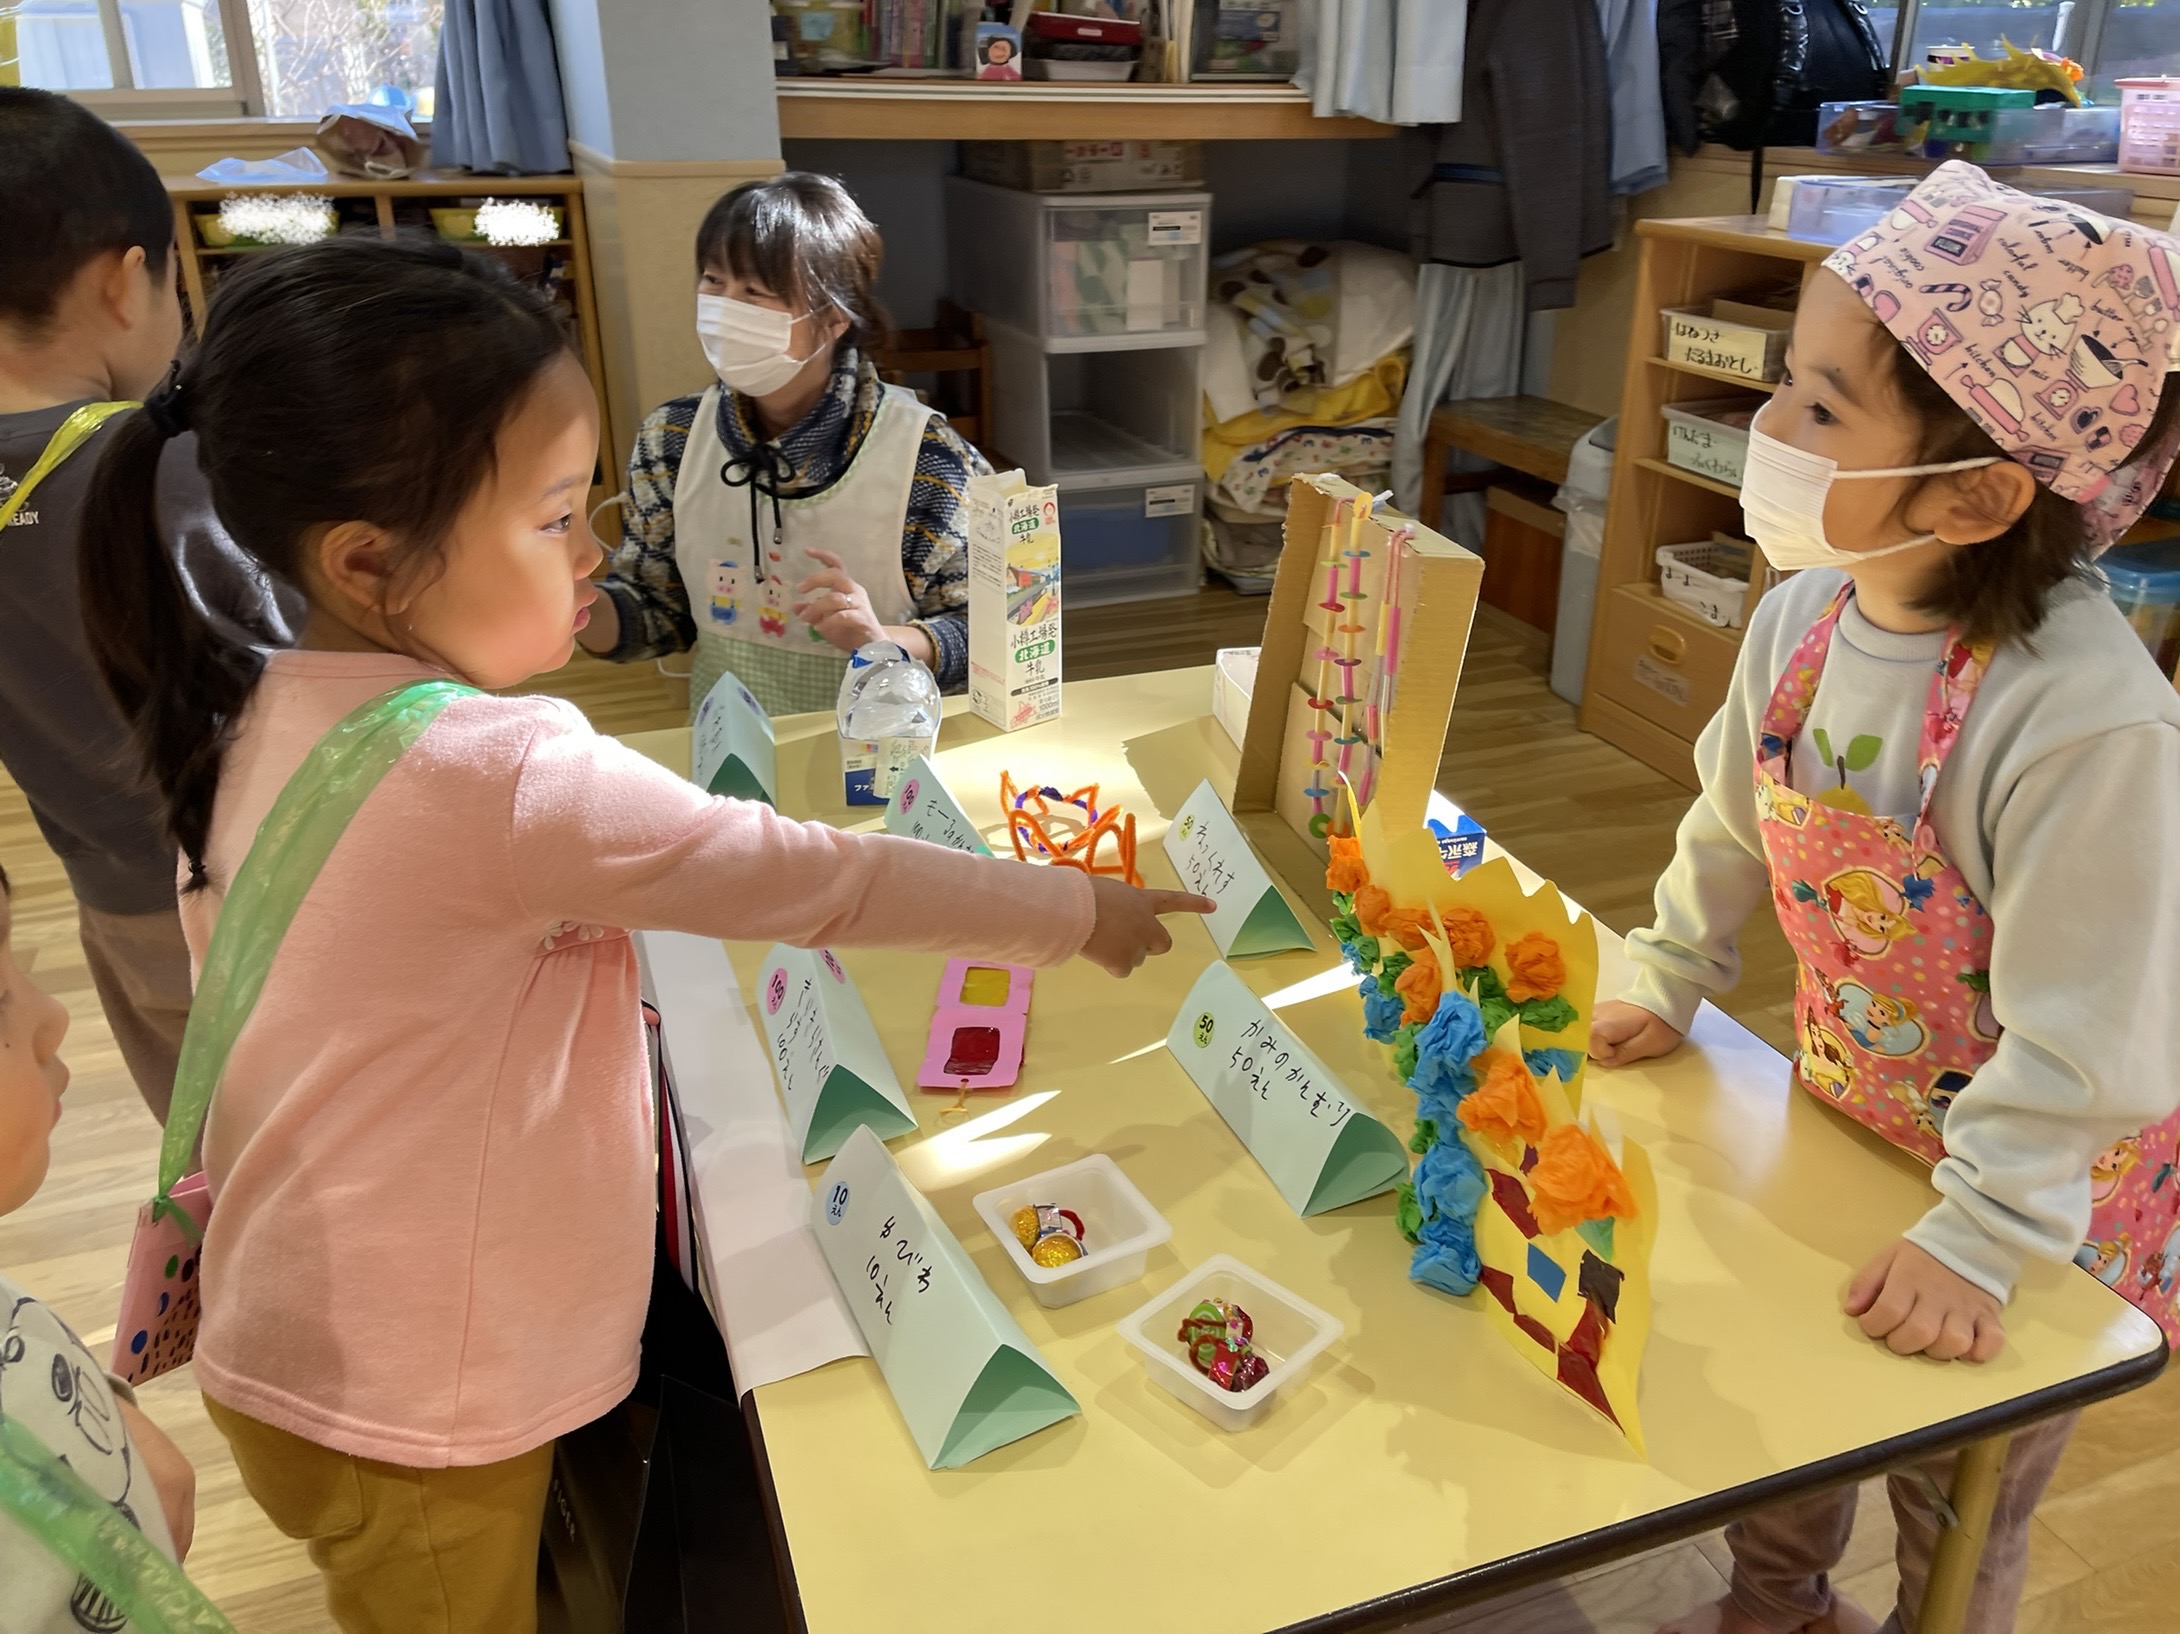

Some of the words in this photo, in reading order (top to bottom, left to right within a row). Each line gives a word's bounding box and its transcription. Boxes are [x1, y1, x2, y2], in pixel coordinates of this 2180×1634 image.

[1900, 248, 1925, 271] cookie
[1998, 238, 2039, 271] colorful
[1869, 255, 1913, 289] original
[2004, 271, 2029, 298] candy
[1965, 343, 1996, 378] kitchen
[2030, 412, 2058, 442] kitchen
[1019, 641, 1050, 661] 北海道
[1025, 659, 1045, 676] 牛乳
[904, 784, 915, 806] 100
[1184, 816, 1194, 830] 50
[1196, 820, 1236, 894] ねっくれす
[771, 974, 784, 999] 100
[1199, 1015, 1214, 1033] 50
[1198, 1033, 1209, 1046] えん
[1230, 1046, 1269, 1100] 50えん
[1241, 1019, 1350, 1127] かみのかんむり
[832, 1185, 848, 1204] 10
[831, 1206, 842, 1218] えん
[879, 1215, 933, 1293] ゆびわ
[866, 1255, 894, 1326] 10えん
